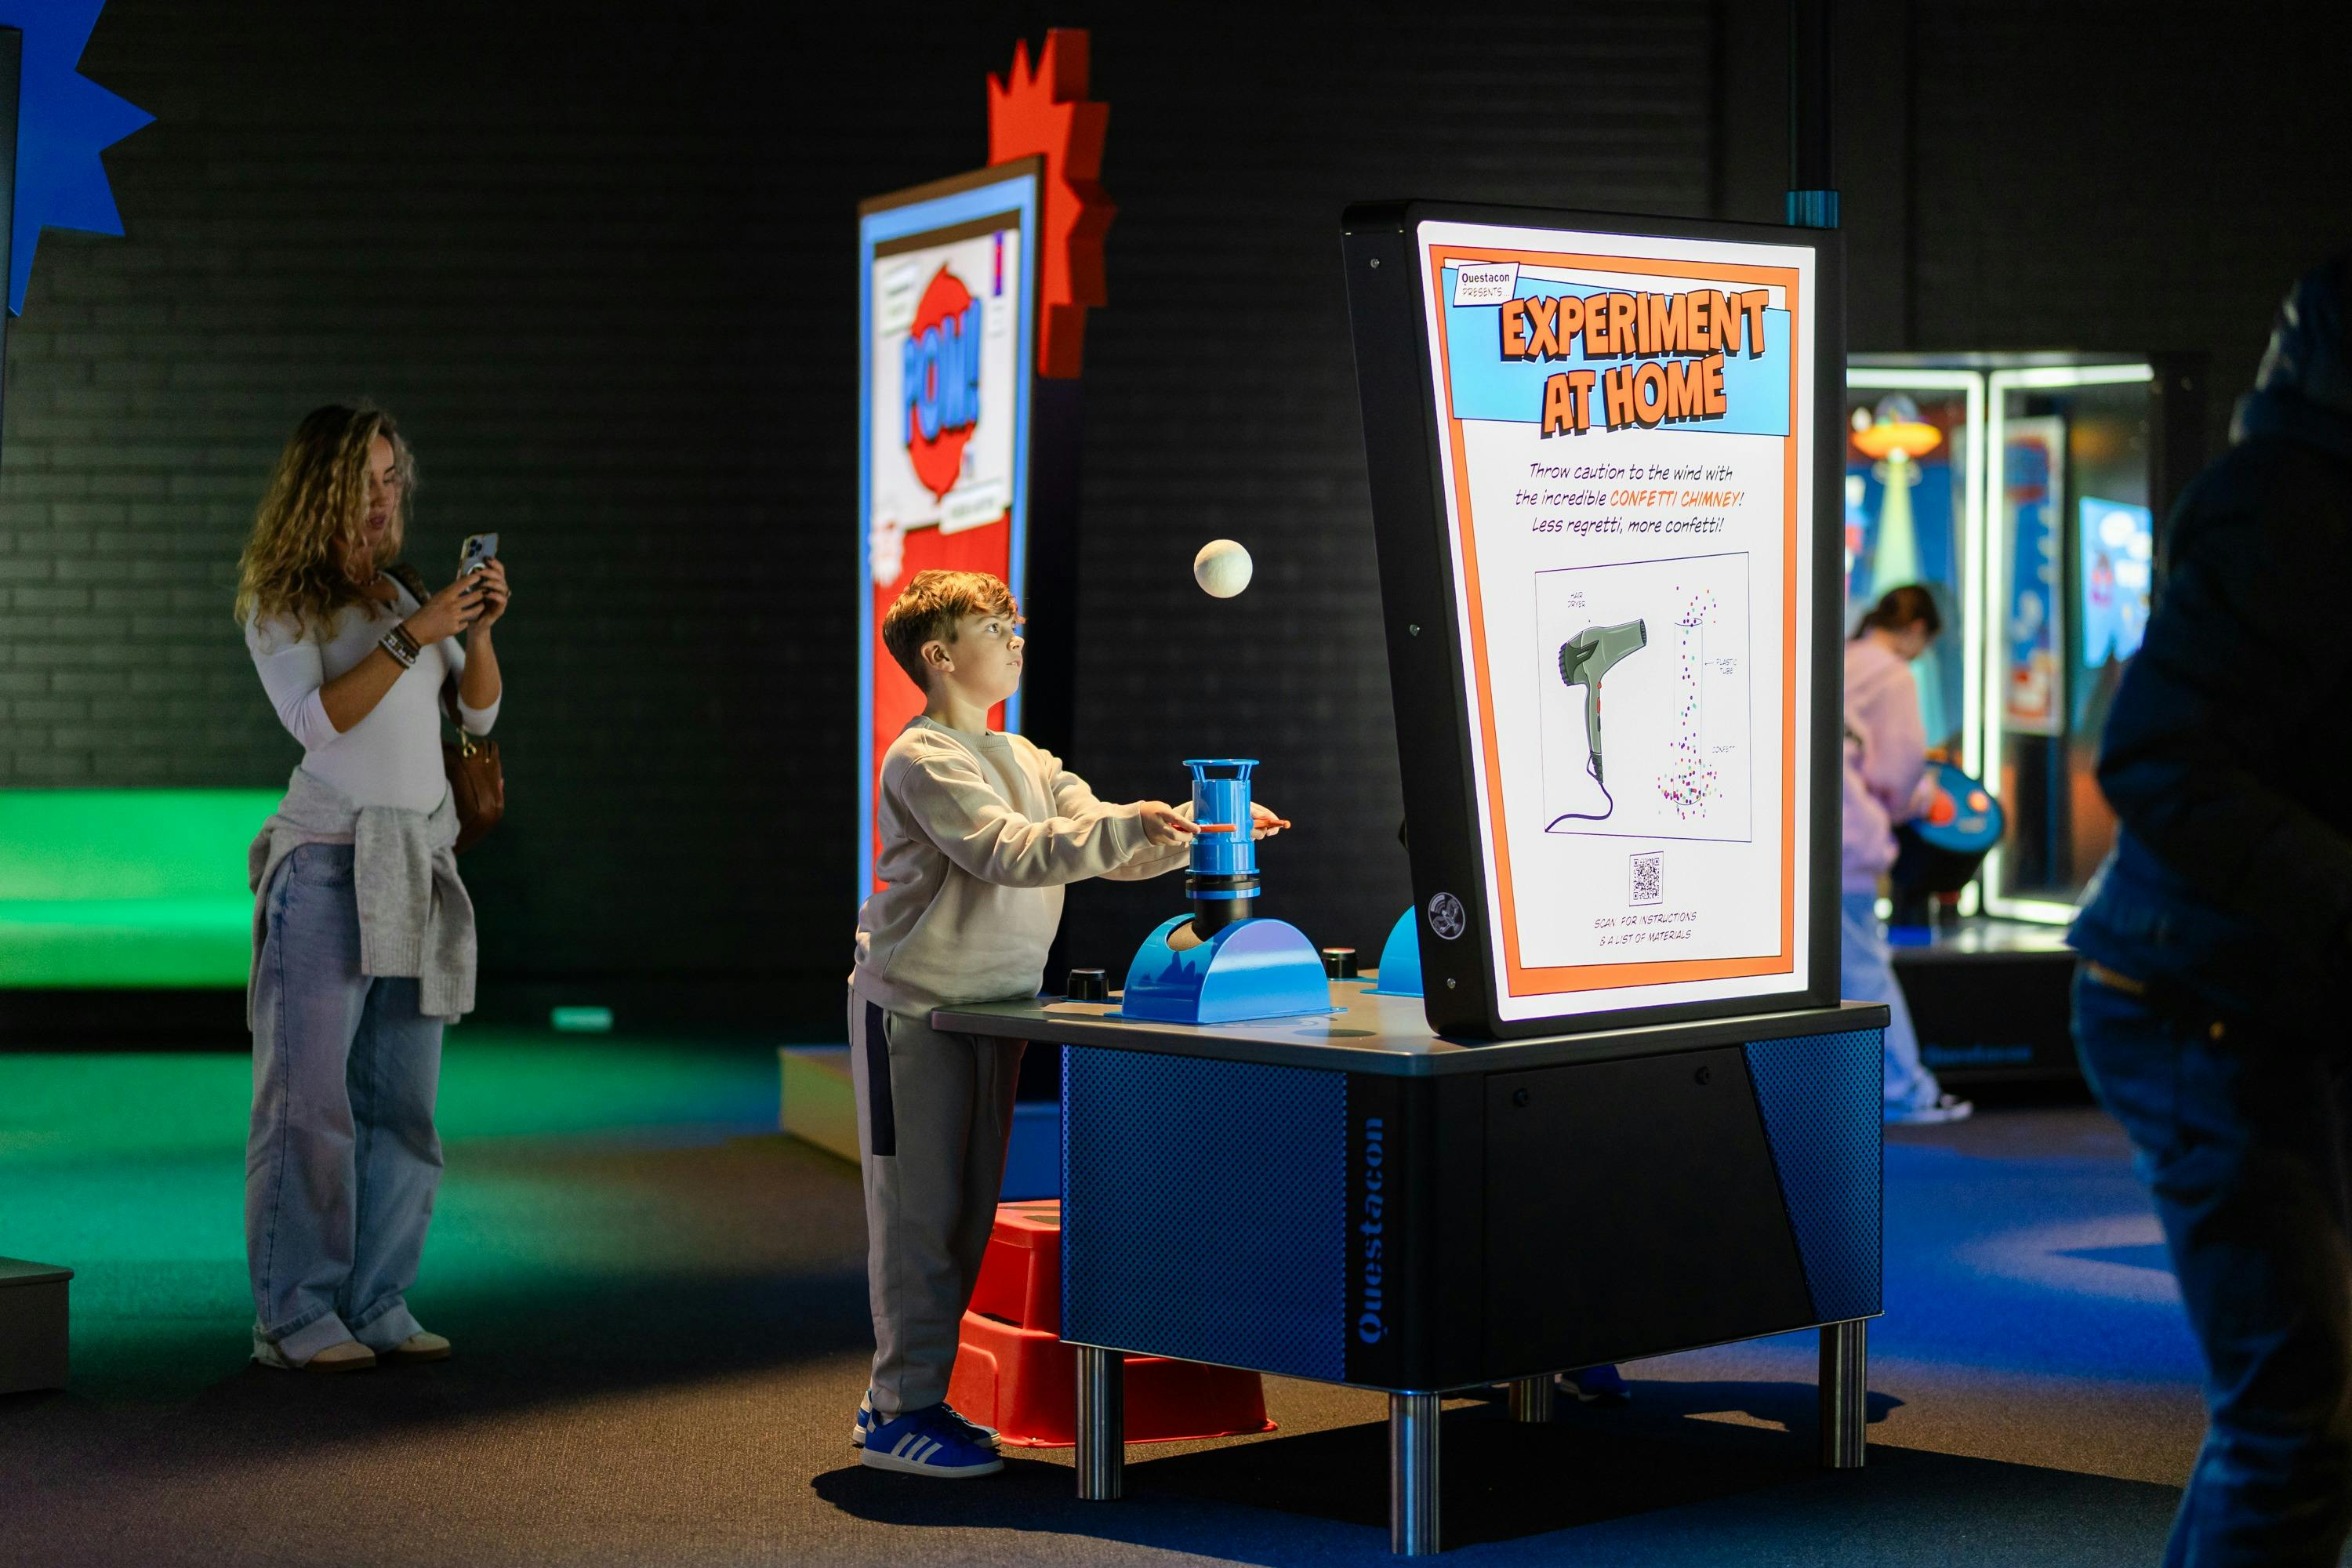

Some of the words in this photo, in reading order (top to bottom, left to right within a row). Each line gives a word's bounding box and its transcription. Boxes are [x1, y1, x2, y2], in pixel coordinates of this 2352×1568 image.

[1462, 273, 1510, 285] Questacon
[1501, 289, 1769, 360] EXPERIMENT
[1541, 369, 1596, 439] AT
[1602, 352, 1727, 433] HOME
[1530, 463, 1571, 478] Throw
[1573, 463, 1625, 479] caution
[1629, 464, 1644, 480] to
[1649, 464, 1670, 480] the
[1674, 465, 1704, 481] wind
[1706, 465, 1733, 481] with
[1515, 489, 1537, 506] the
[1541, 489, 1606, 506] incredible
[1610, 490, 1678, 506] CONFETTI
[1681, 491, 1744, 507] CHIMNEY!
[1532, 517, 1563, 532] Less
[1566, 517, 1623, 536] regretti,
[1628, 521, 1662, 533] more
[1665, 517, 1725, 533] confetti!
[1594, 919, 1616, 928] SCAN
[1621, 916, 1638, 926] FOR
[1639, 911, 1697, 925] INSTRUCTIONS
[1599, 936, 1606, 946] &
[1615, 935, 1634, 944] LIST
[1635, 932, 1646, 943] OF
[1648, 929, 1691, 942] MATERIALS
[1359, 1118, 1388, 1344] Questacon
